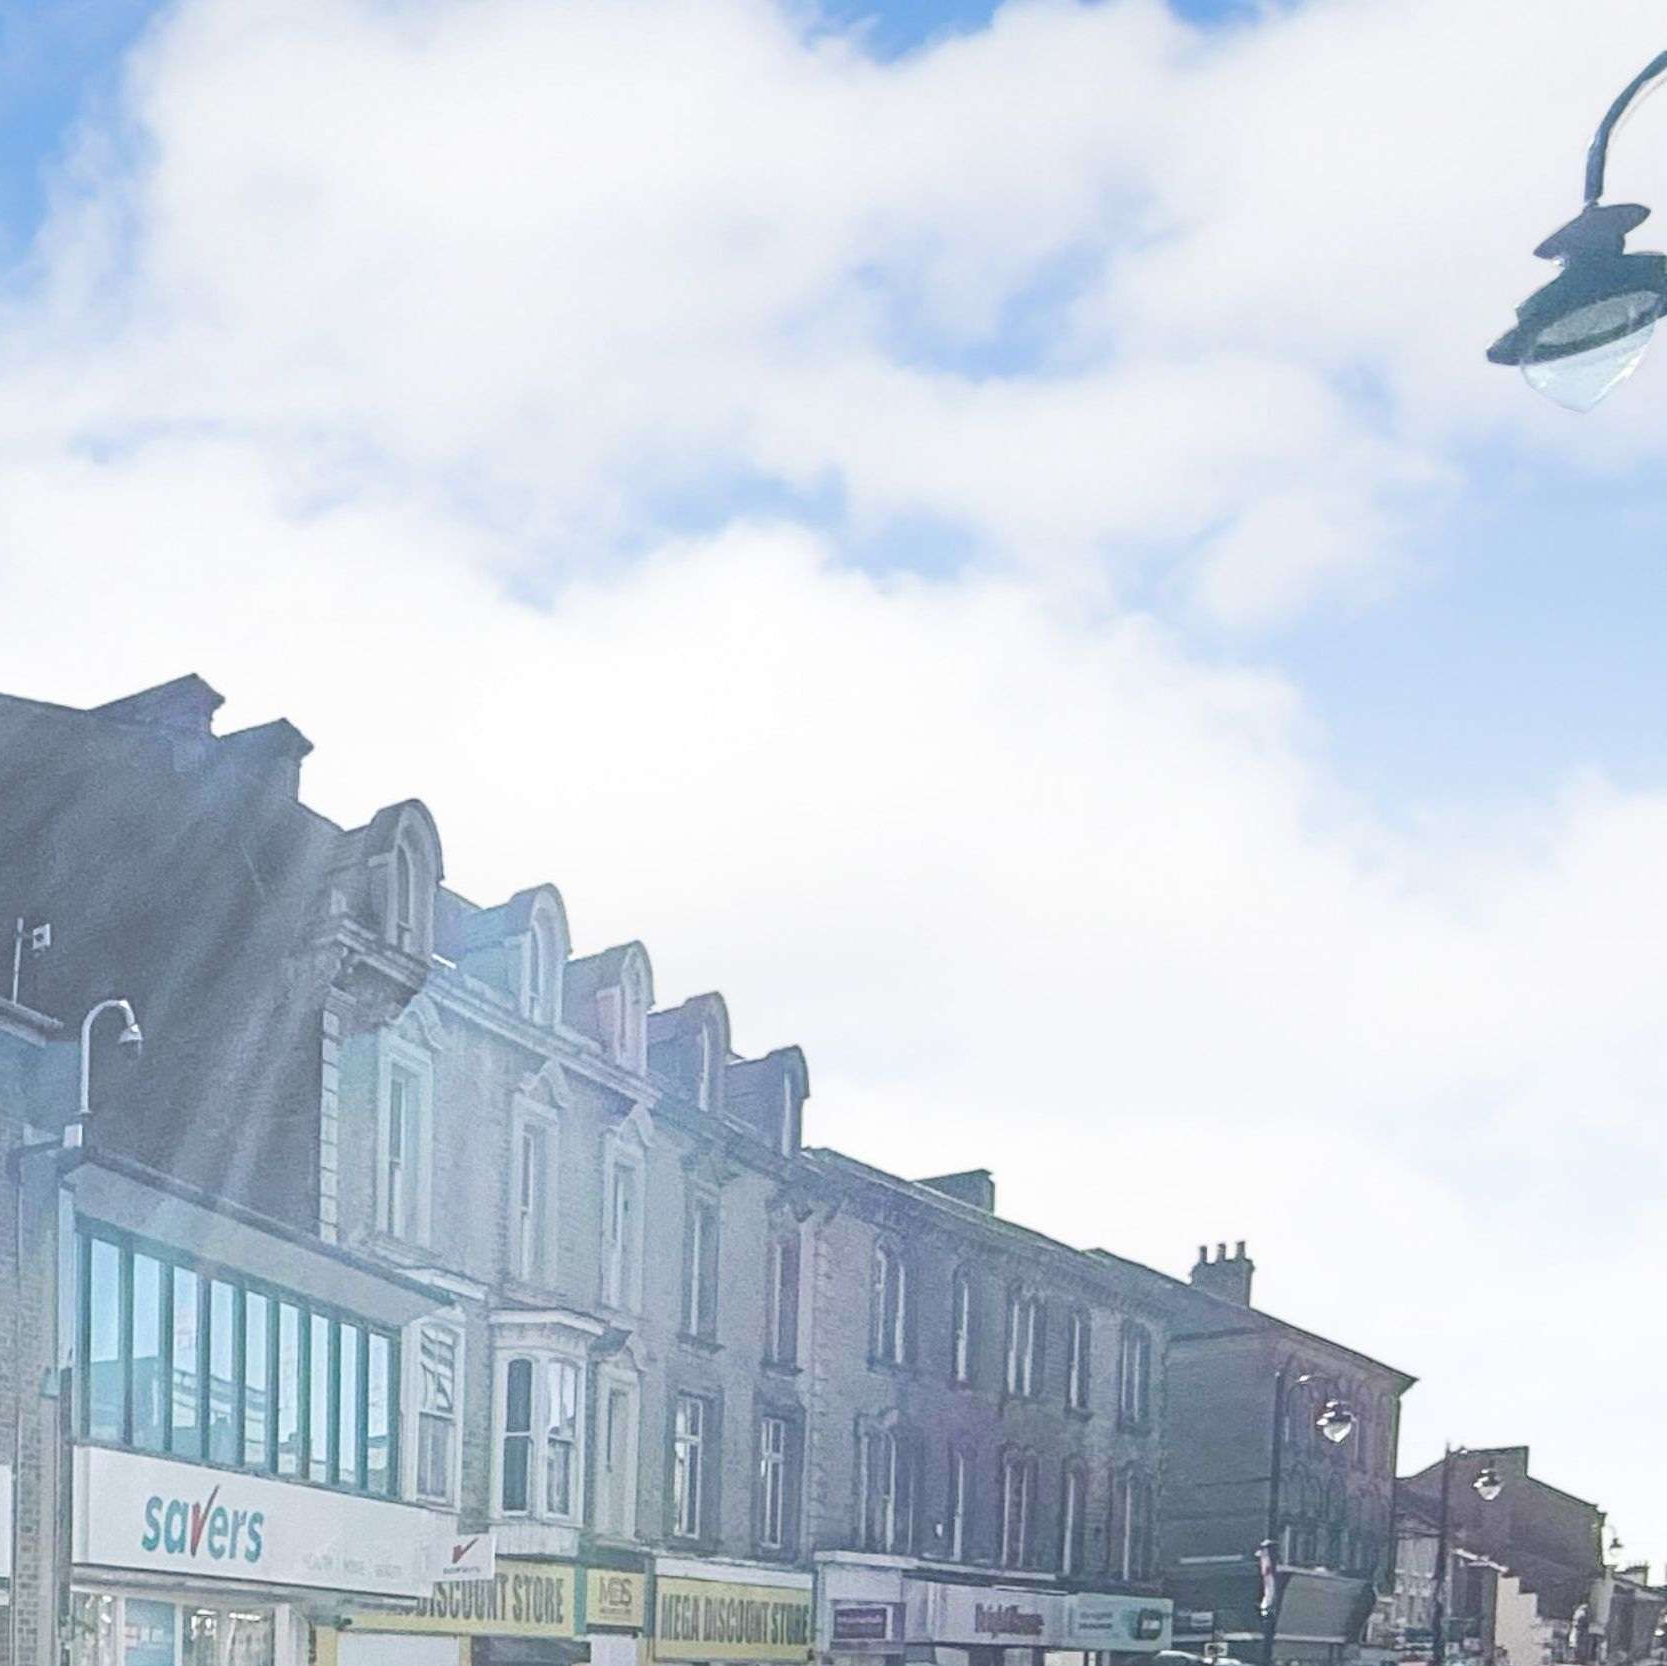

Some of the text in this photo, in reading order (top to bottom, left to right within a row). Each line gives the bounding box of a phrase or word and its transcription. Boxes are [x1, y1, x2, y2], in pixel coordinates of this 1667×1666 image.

[141, 1484, 264, 1564] savers
[512, 1573, 564, 1624] STORE
[660, 1593, 810, 1646] MEGA DISCOUNT STORE
